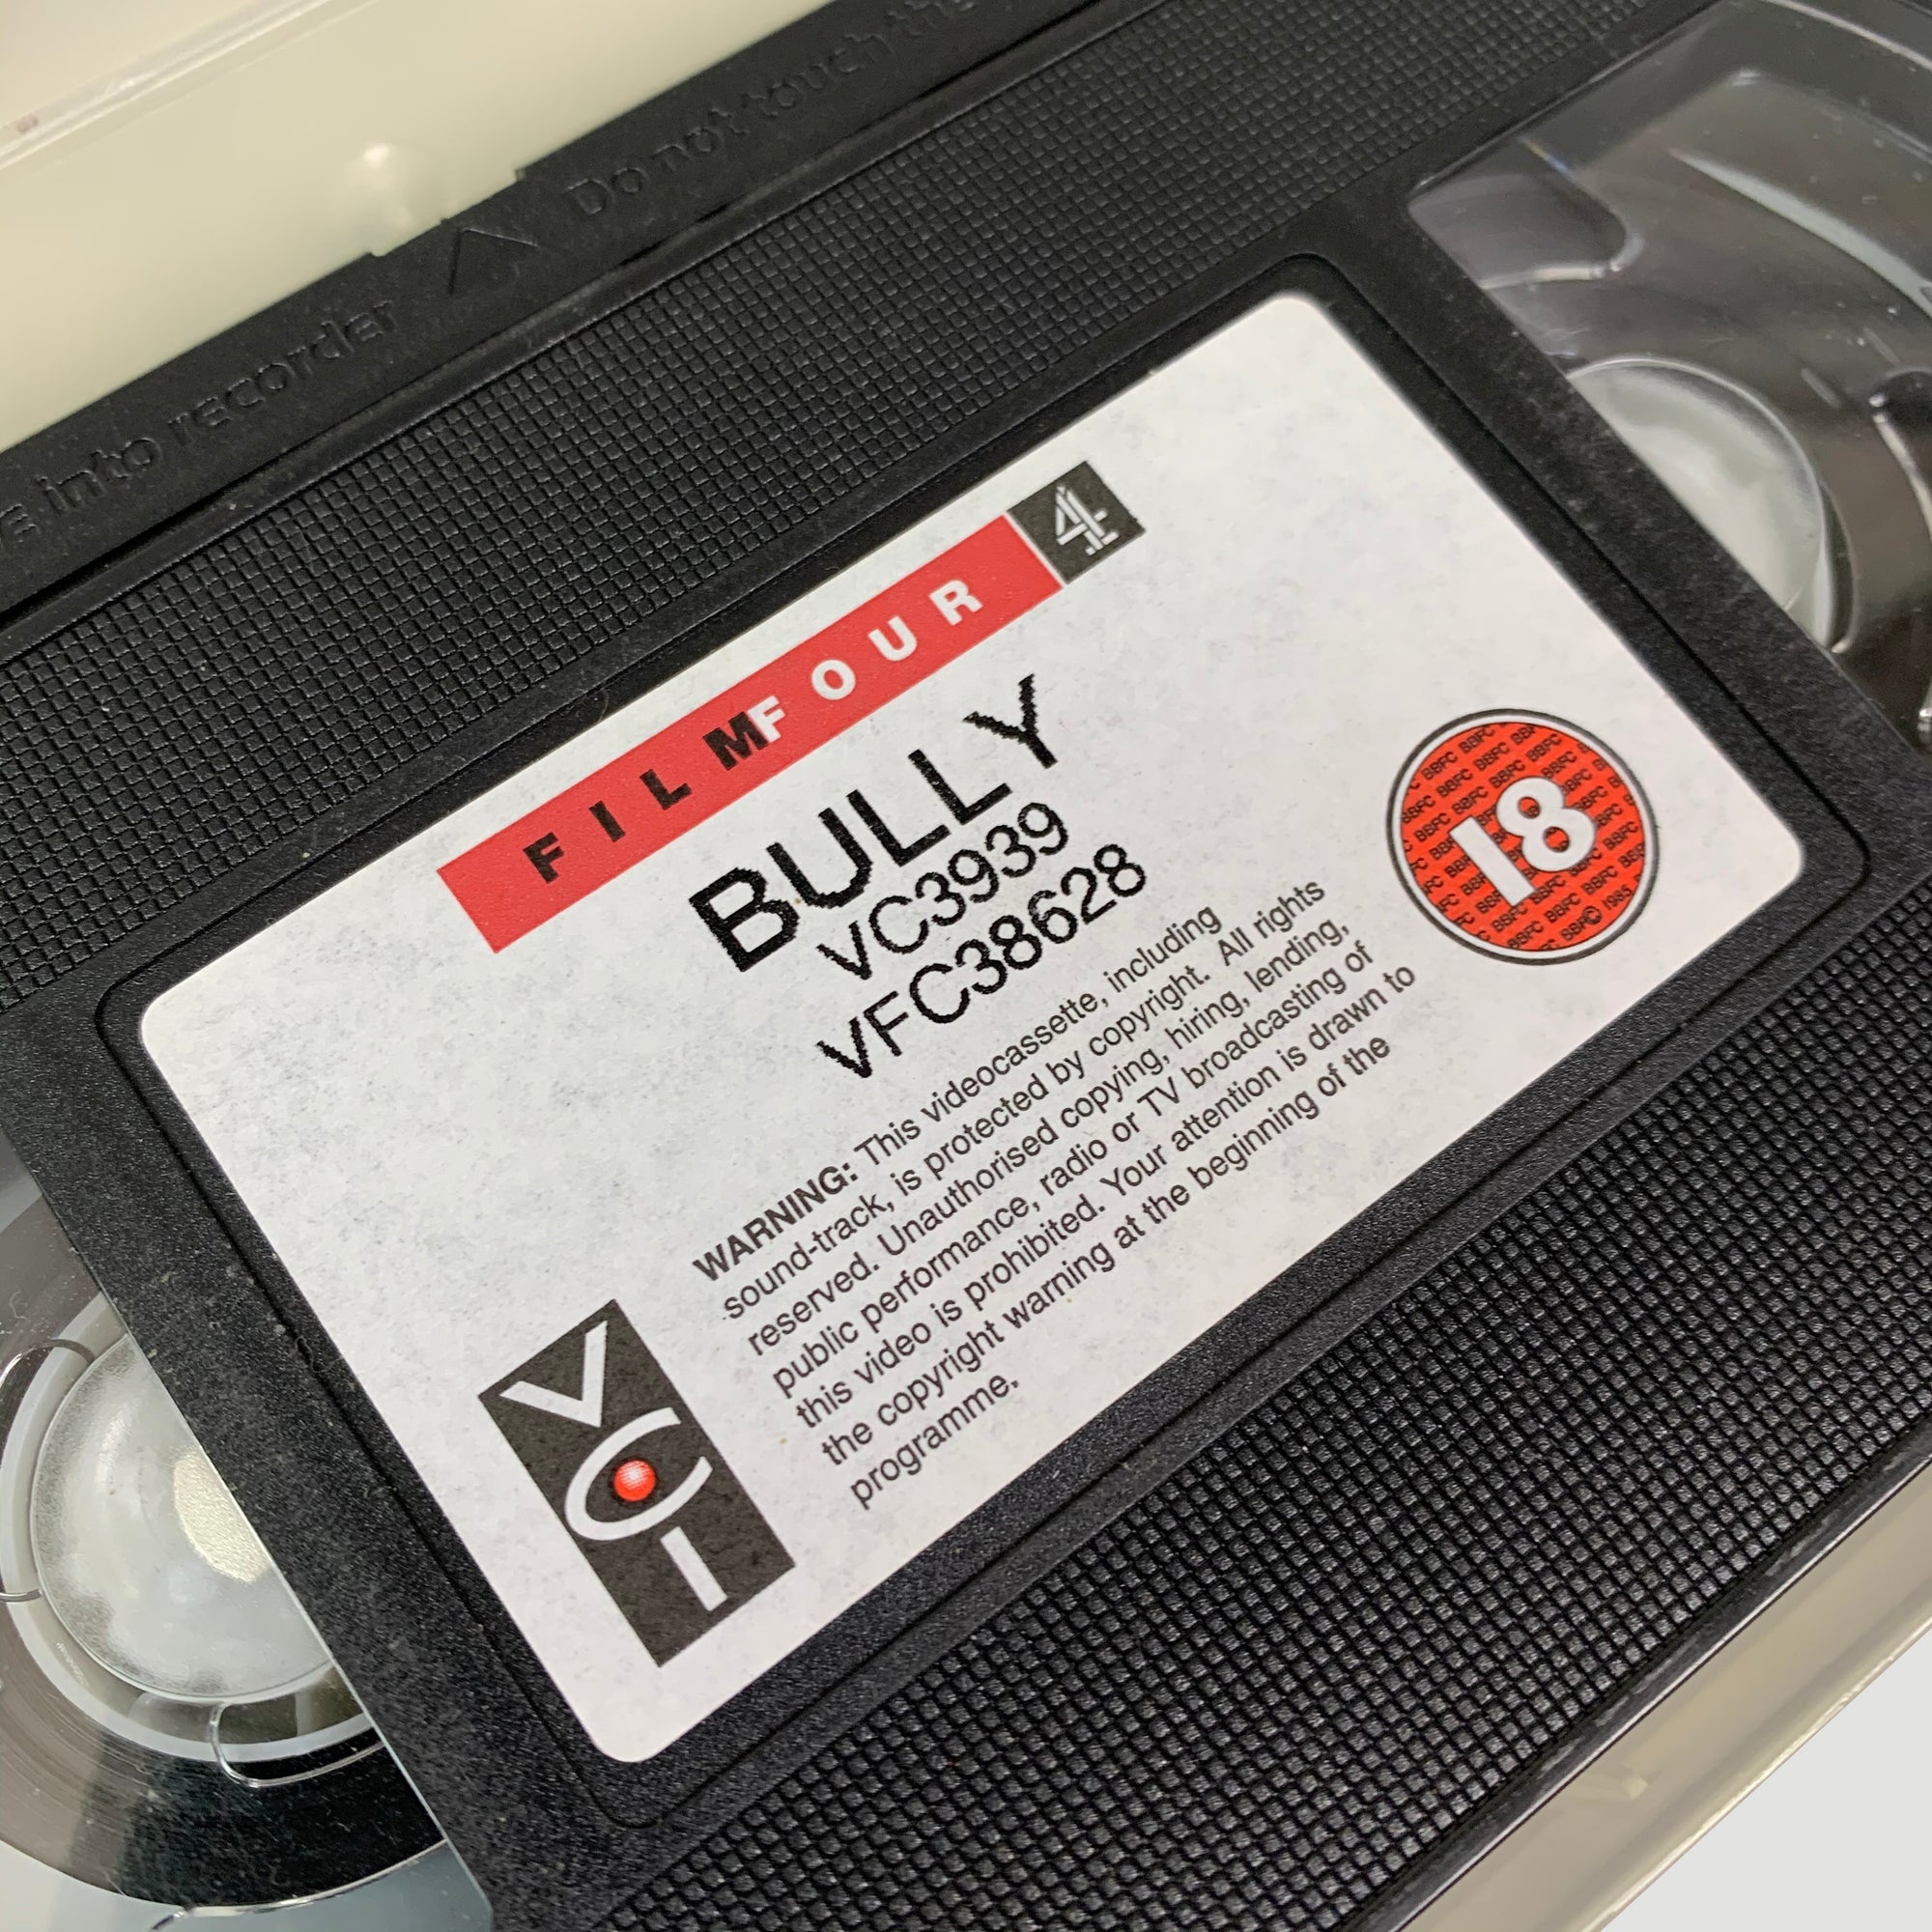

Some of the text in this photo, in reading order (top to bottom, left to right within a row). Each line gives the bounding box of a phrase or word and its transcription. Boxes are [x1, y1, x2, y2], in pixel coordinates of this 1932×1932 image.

[563, 164, 649, 215] Do
[650, 106, 752, 174] not
[738, 31, 896, 118] touch
[34, 436, 163, 516] into
[165, 299, 398, 446] recorder
[688, 672, 1058, 973] BULLY
[815, 842, 1148, 1081] VFC38628
[816, 801, 1069, 981] VC3939
[1448, 774, 1596, 908] 18
[694, 908, 1223, 1281] WARNING: This videocassette, including
[725, 881, 1325, 1319] sound-track, is protected by copyright. All rights
[748, 918, 1350, 1355] reserved. Unauthorised copying, hiring, lending,
[774, 940, 1375, 1399] public performance, radio or TV broadcasting of
[796, 967, 1415, 1428] this video is prohibited. Your attention is drawn to
[822, 1037, 1391, 1465] the copyright warning at the beginning of the
[498, 1320, 728, 1612] VCI
[850, 1376, 1019, 1511] programme.
